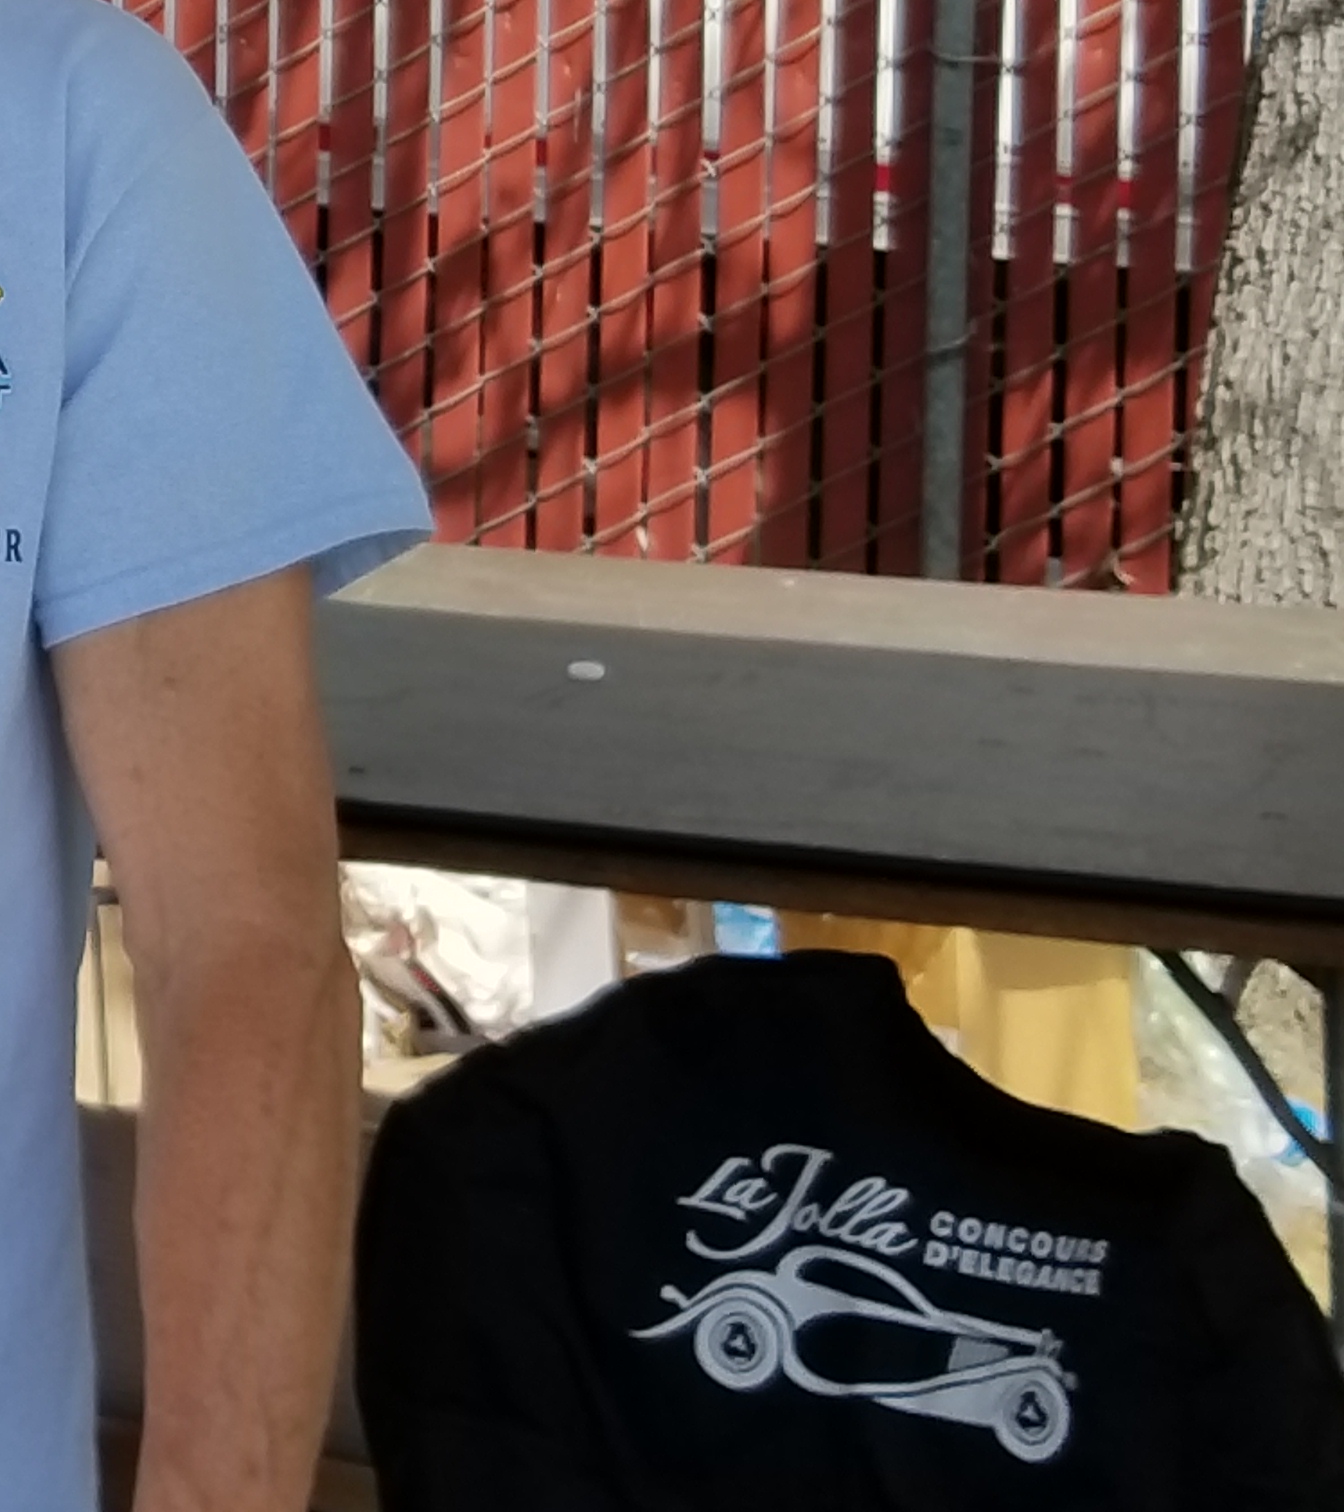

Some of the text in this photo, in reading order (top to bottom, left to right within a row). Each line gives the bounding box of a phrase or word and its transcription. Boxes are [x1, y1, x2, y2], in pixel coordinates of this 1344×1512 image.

[676, 1143, 918, 1260] La Jolla
[929, 1211, 1110, 1264] CONCOURS
[924, 1241, 1101, 1296] D'ELEGANCE
